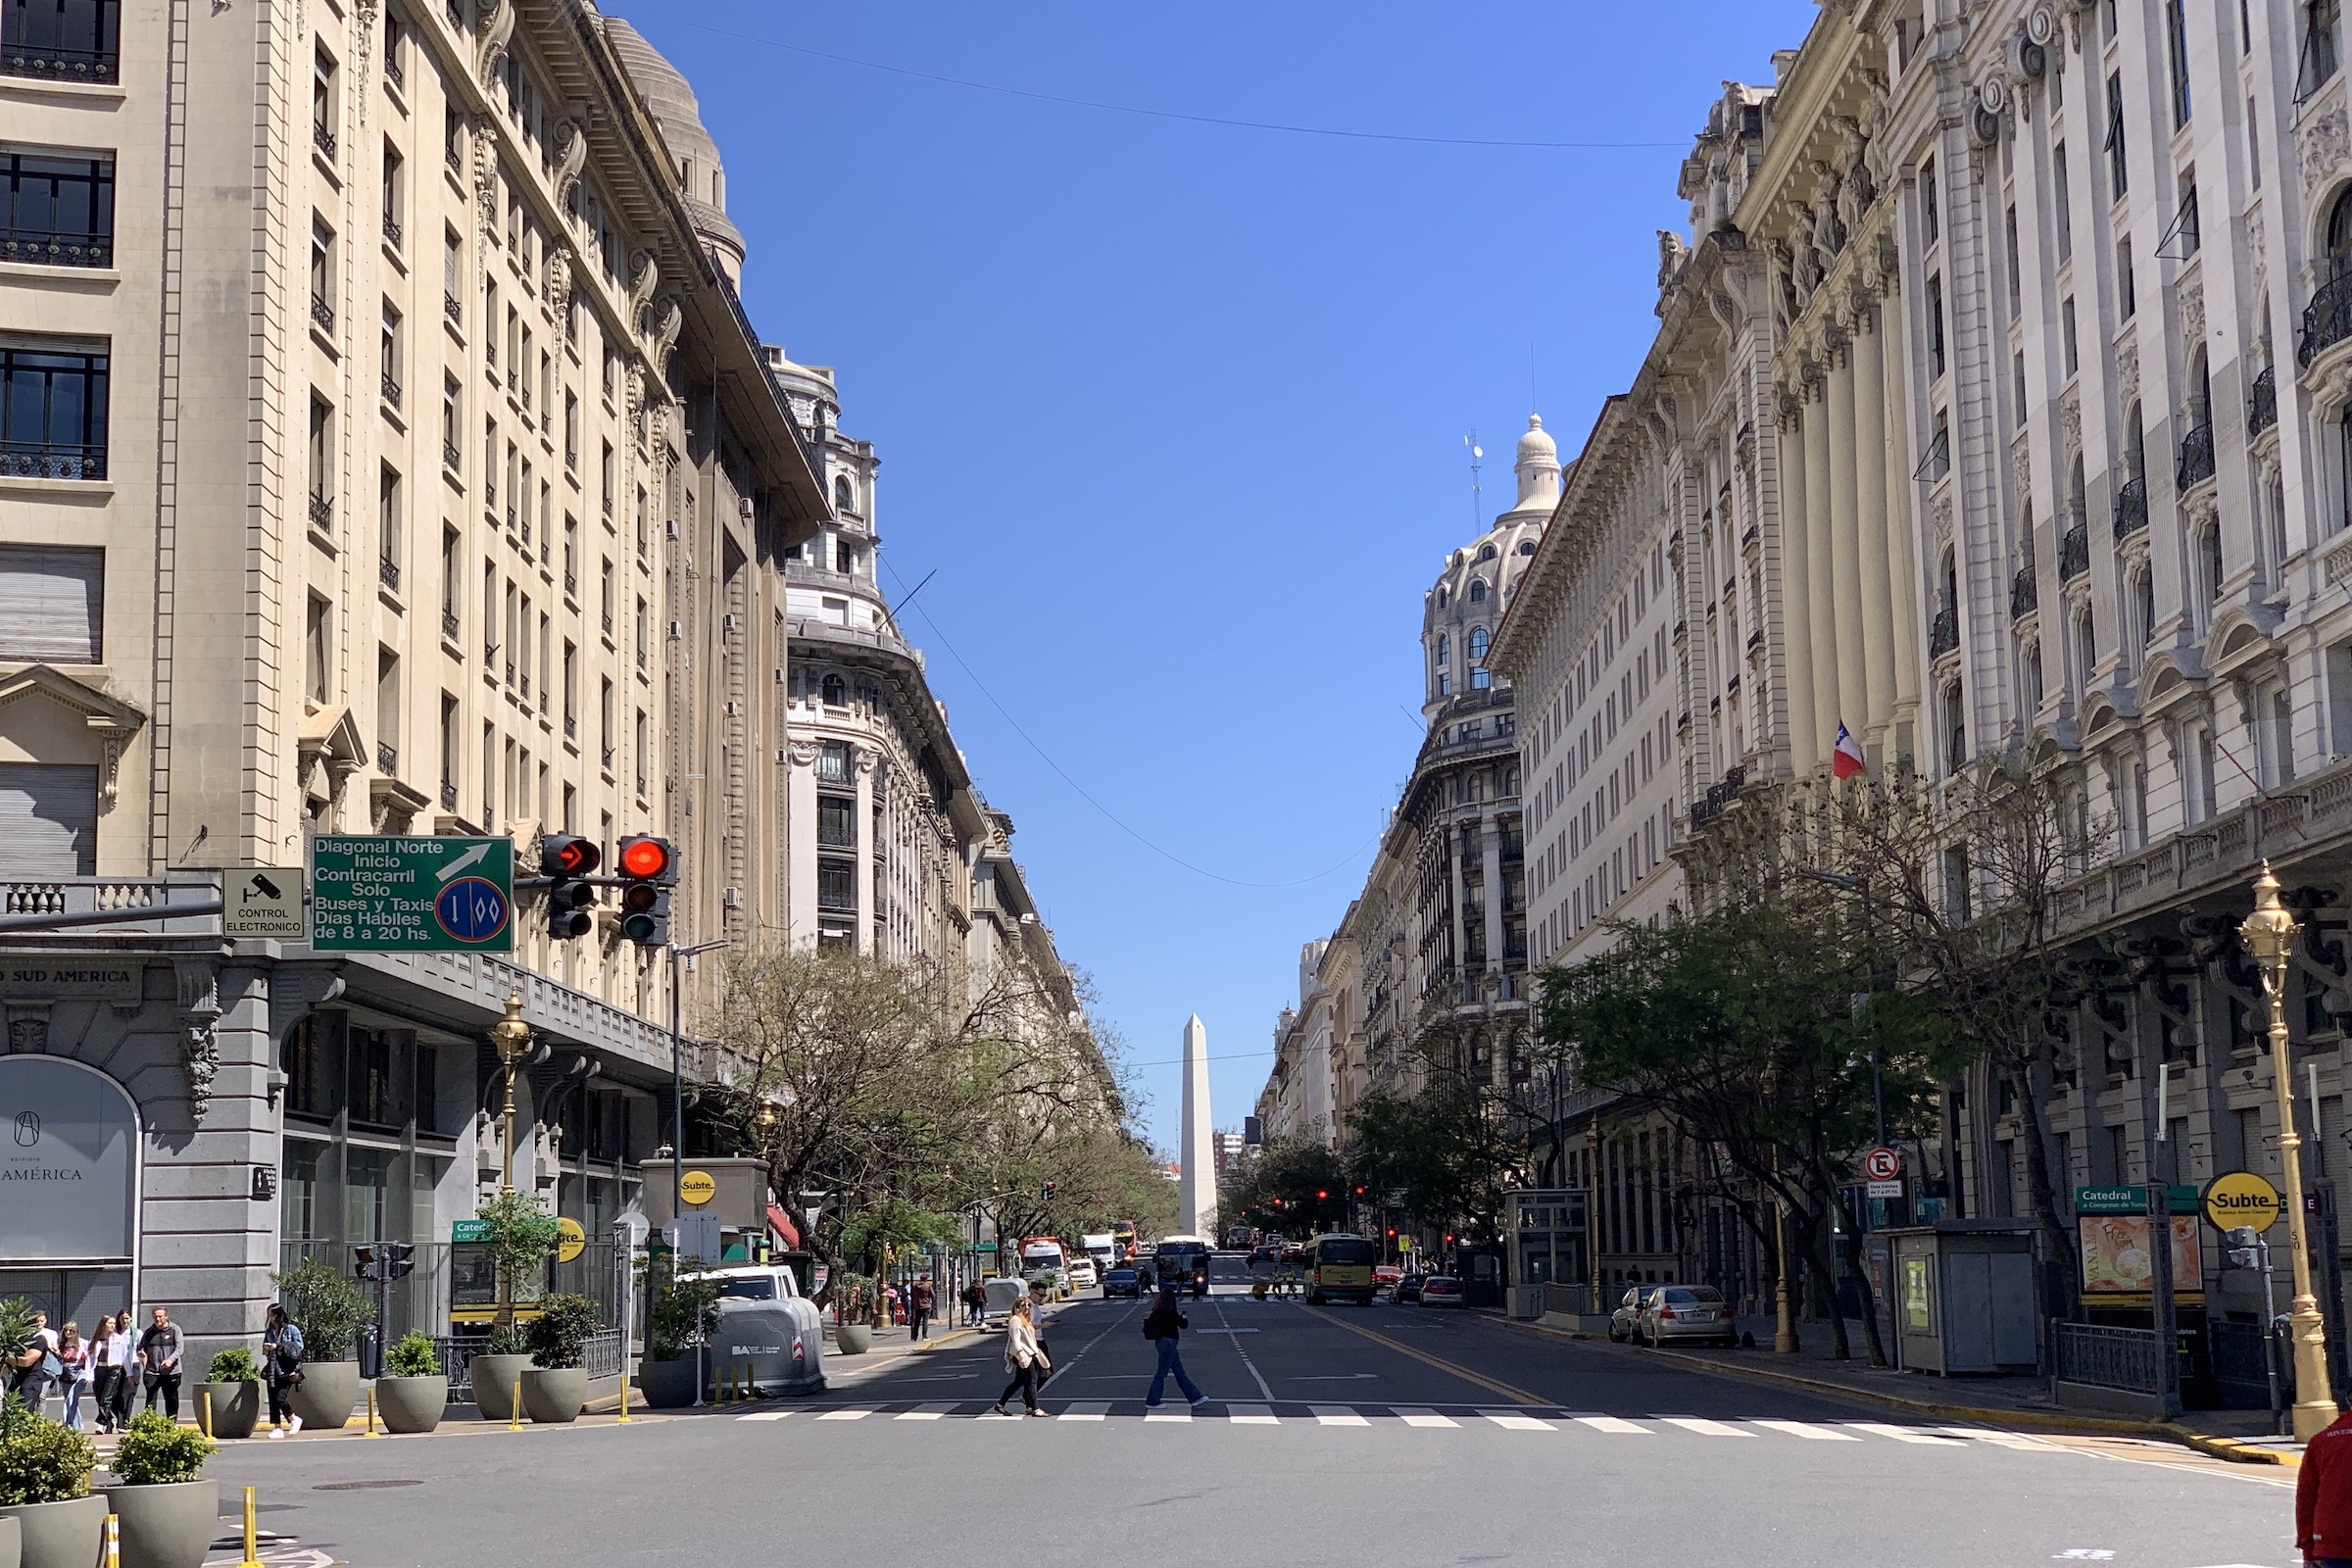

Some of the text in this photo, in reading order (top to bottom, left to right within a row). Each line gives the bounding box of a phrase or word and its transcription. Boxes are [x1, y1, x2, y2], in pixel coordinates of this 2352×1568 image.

[315, 839, 444, 856] Diagonal Norte
[355, 855, 401, 868] Inicio
[315, 867, 416, 883] Contracarril
[351, 883, 391, 897] Solo
[315, 897, 435, 913] Buses y Taxis
[238, 908, 289, 918] CONTROL
[226, 922, 301, 931] ELECTRONICO
[314, 925, 432, 941] de 8 a 20 hs.
[13, 970, 47, 982] SUD
[53, 970, 130, 982] AMERICA
[1, 1166, 82, 1180] AMÉRICA
[683, 1181, 711, 1190] Subte
[2082, 1191, 2132, 1200] Catedral
[2216, 1193, 2271, 1208] Subte
[2280, 1199, 2315, 1209] D E
